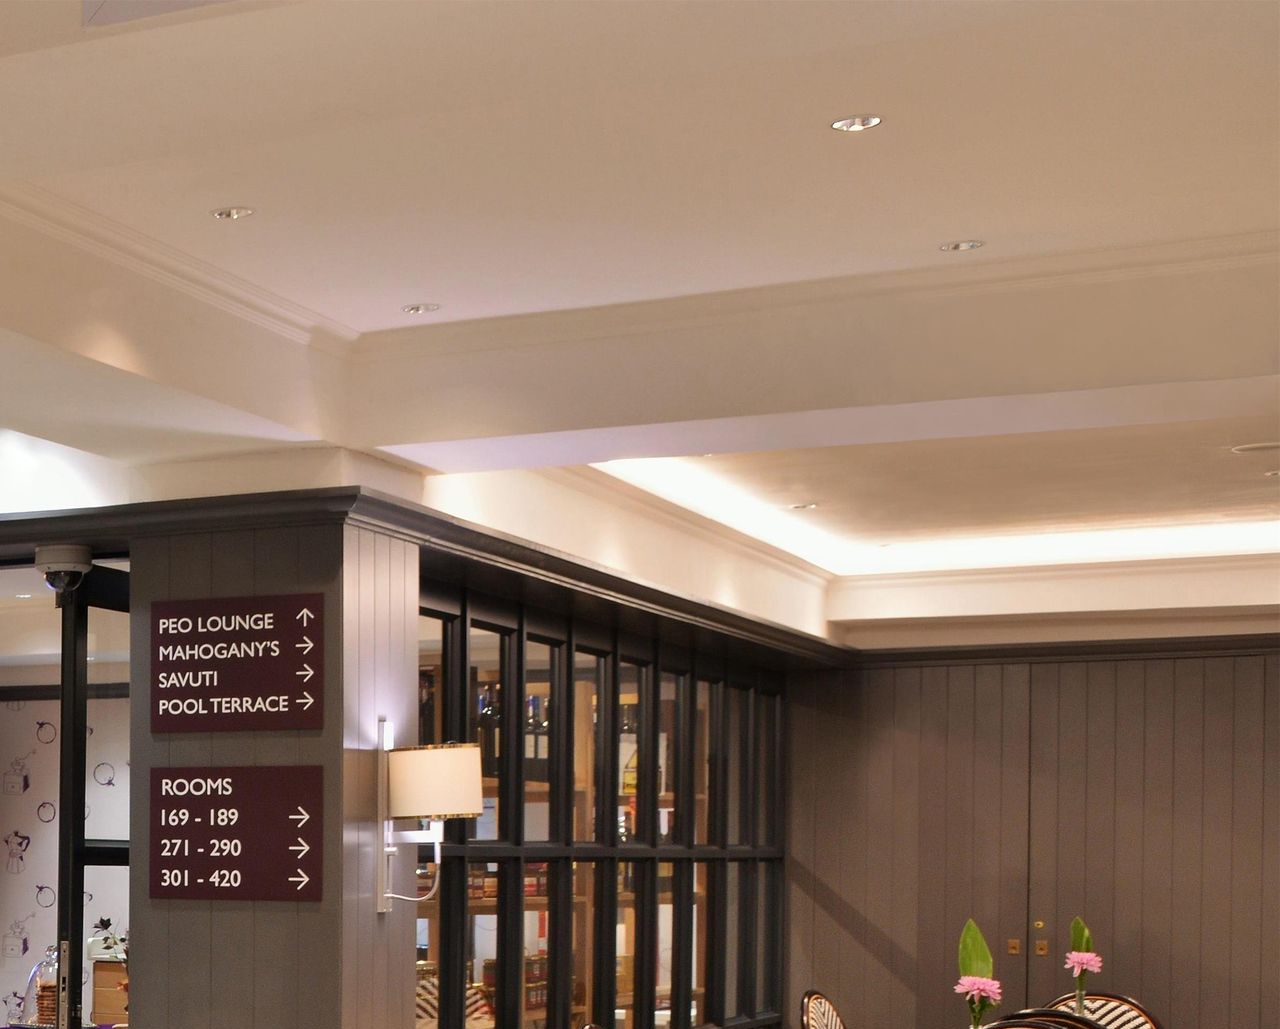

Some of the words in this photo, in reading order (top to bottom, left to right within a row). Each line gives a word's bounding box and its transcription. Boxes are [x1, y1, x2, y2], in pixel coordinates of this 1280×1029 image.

[159, 617, 193, 634] PEO
[198, 613, 274, 633] LOUNGE
[159, 640, 280, 661] MAHOGANY'S
[159, 671, 218, 688] SAVUTI
[159, 698, 208, 715] POOL
[210, 695, 289, 713] TERRACE
[161, 778, 233, 796] ROOMS
[161, 809, 190, 826] 169
[209, 808, 239, 826] 189
[160, 839, 189, 857] 271
[209, 839, 242, 857] 290
[160, 869, 189, 887] 301
[209, 869, 242, 887] 420
